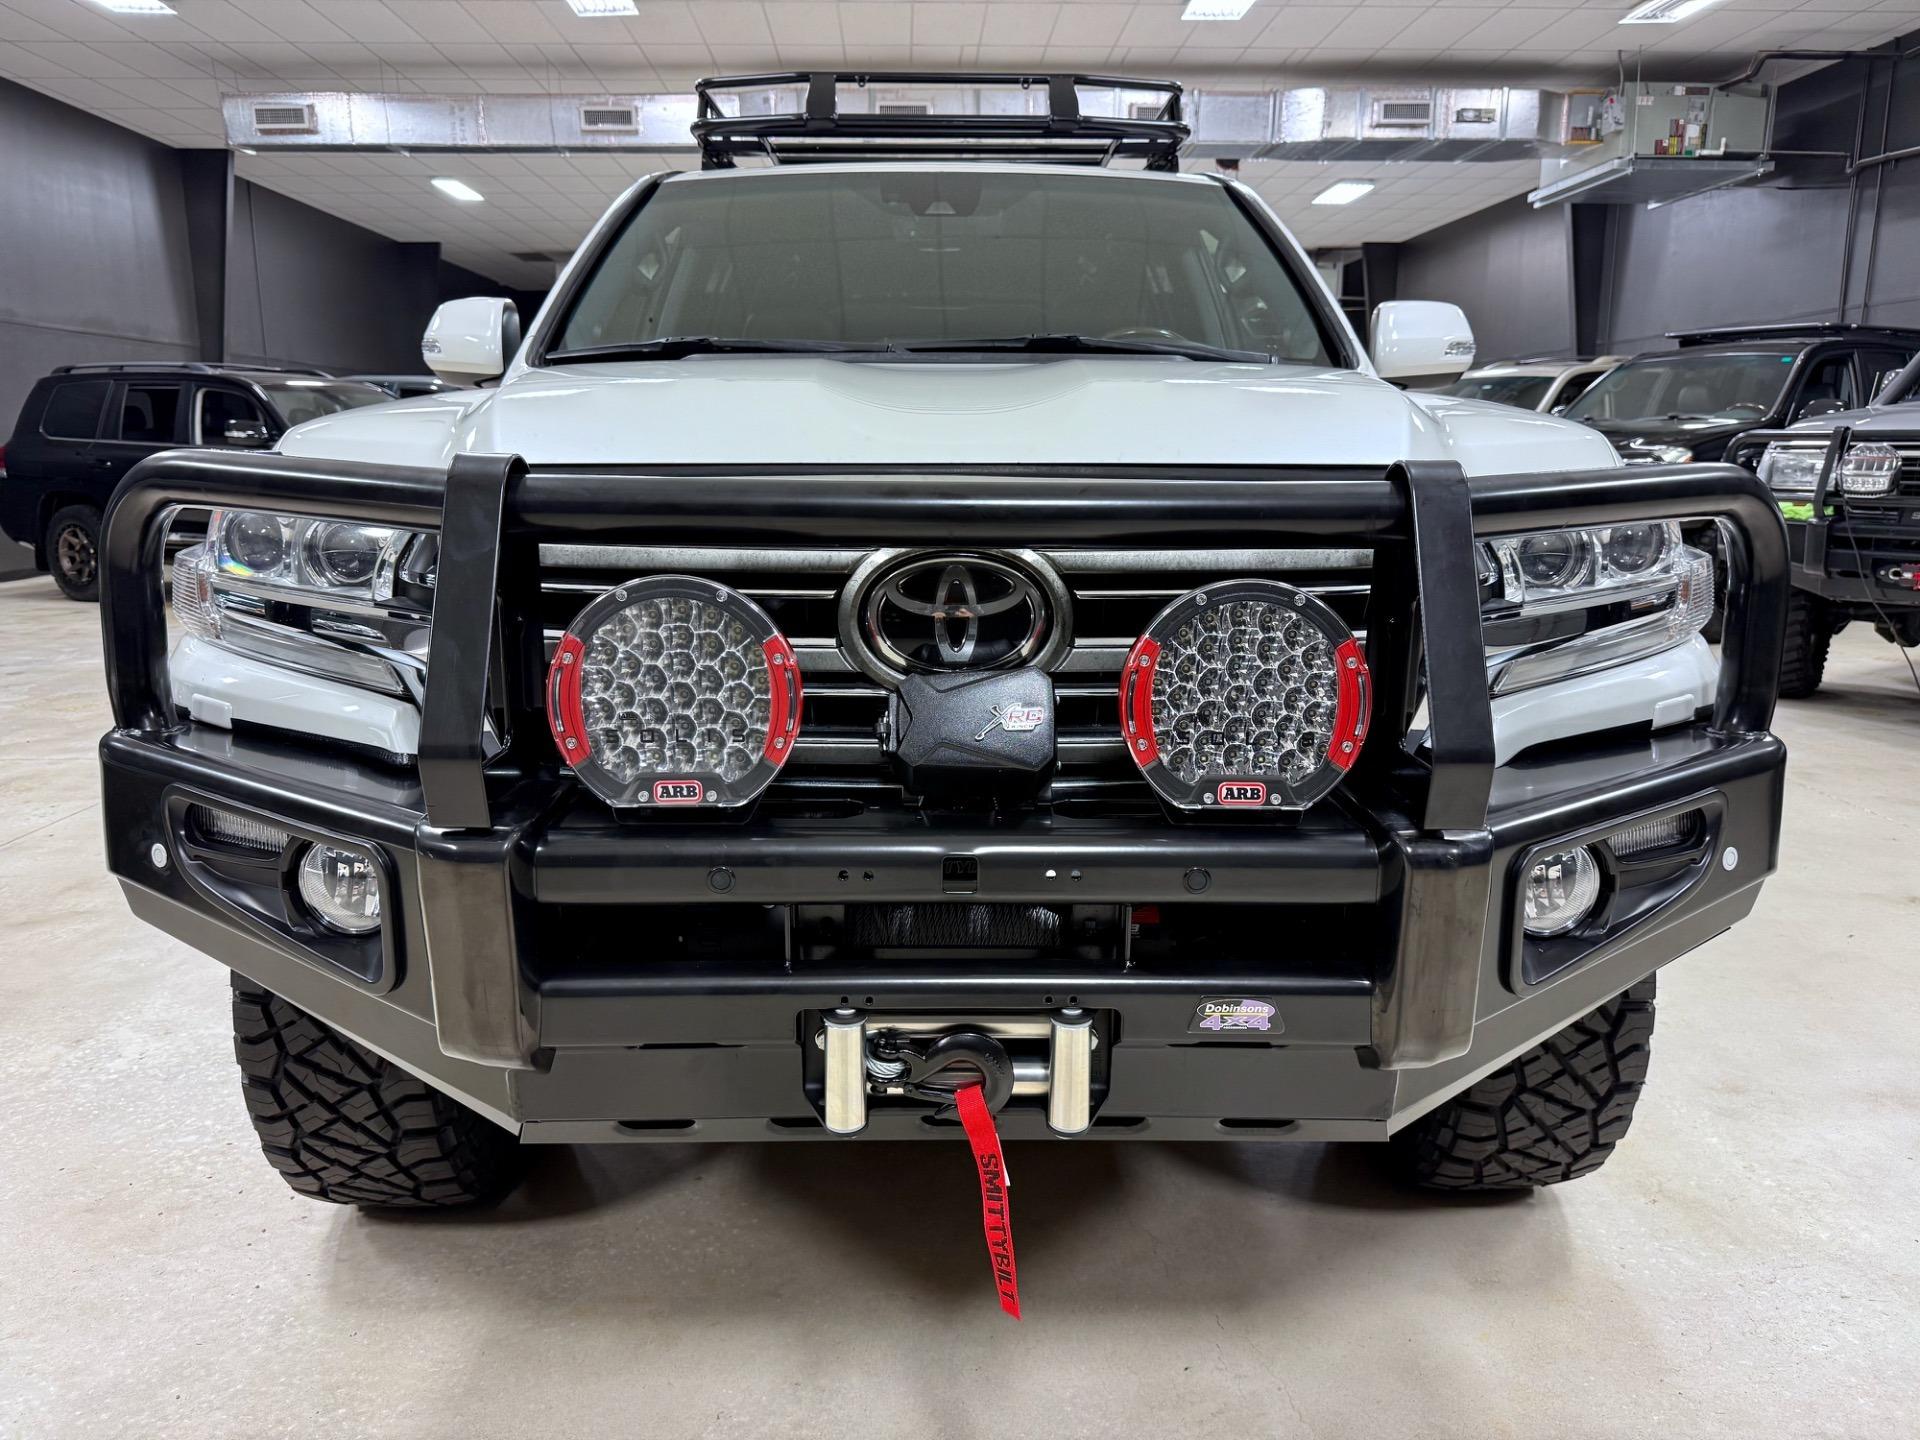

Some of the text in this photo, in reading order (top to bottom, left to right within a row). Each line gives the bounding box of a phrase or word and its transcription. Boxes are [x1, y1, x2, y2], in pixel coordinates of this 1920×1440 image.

[606, 729, 746, 743] SOLIS
[659, 785, 698, 799] ARB
[1224, 787, 1261, 801] ARB
[1205, 1004, 1269, 1013] Dobinsons
[980, 1153, 1015, 1304] SMITTYBILT
